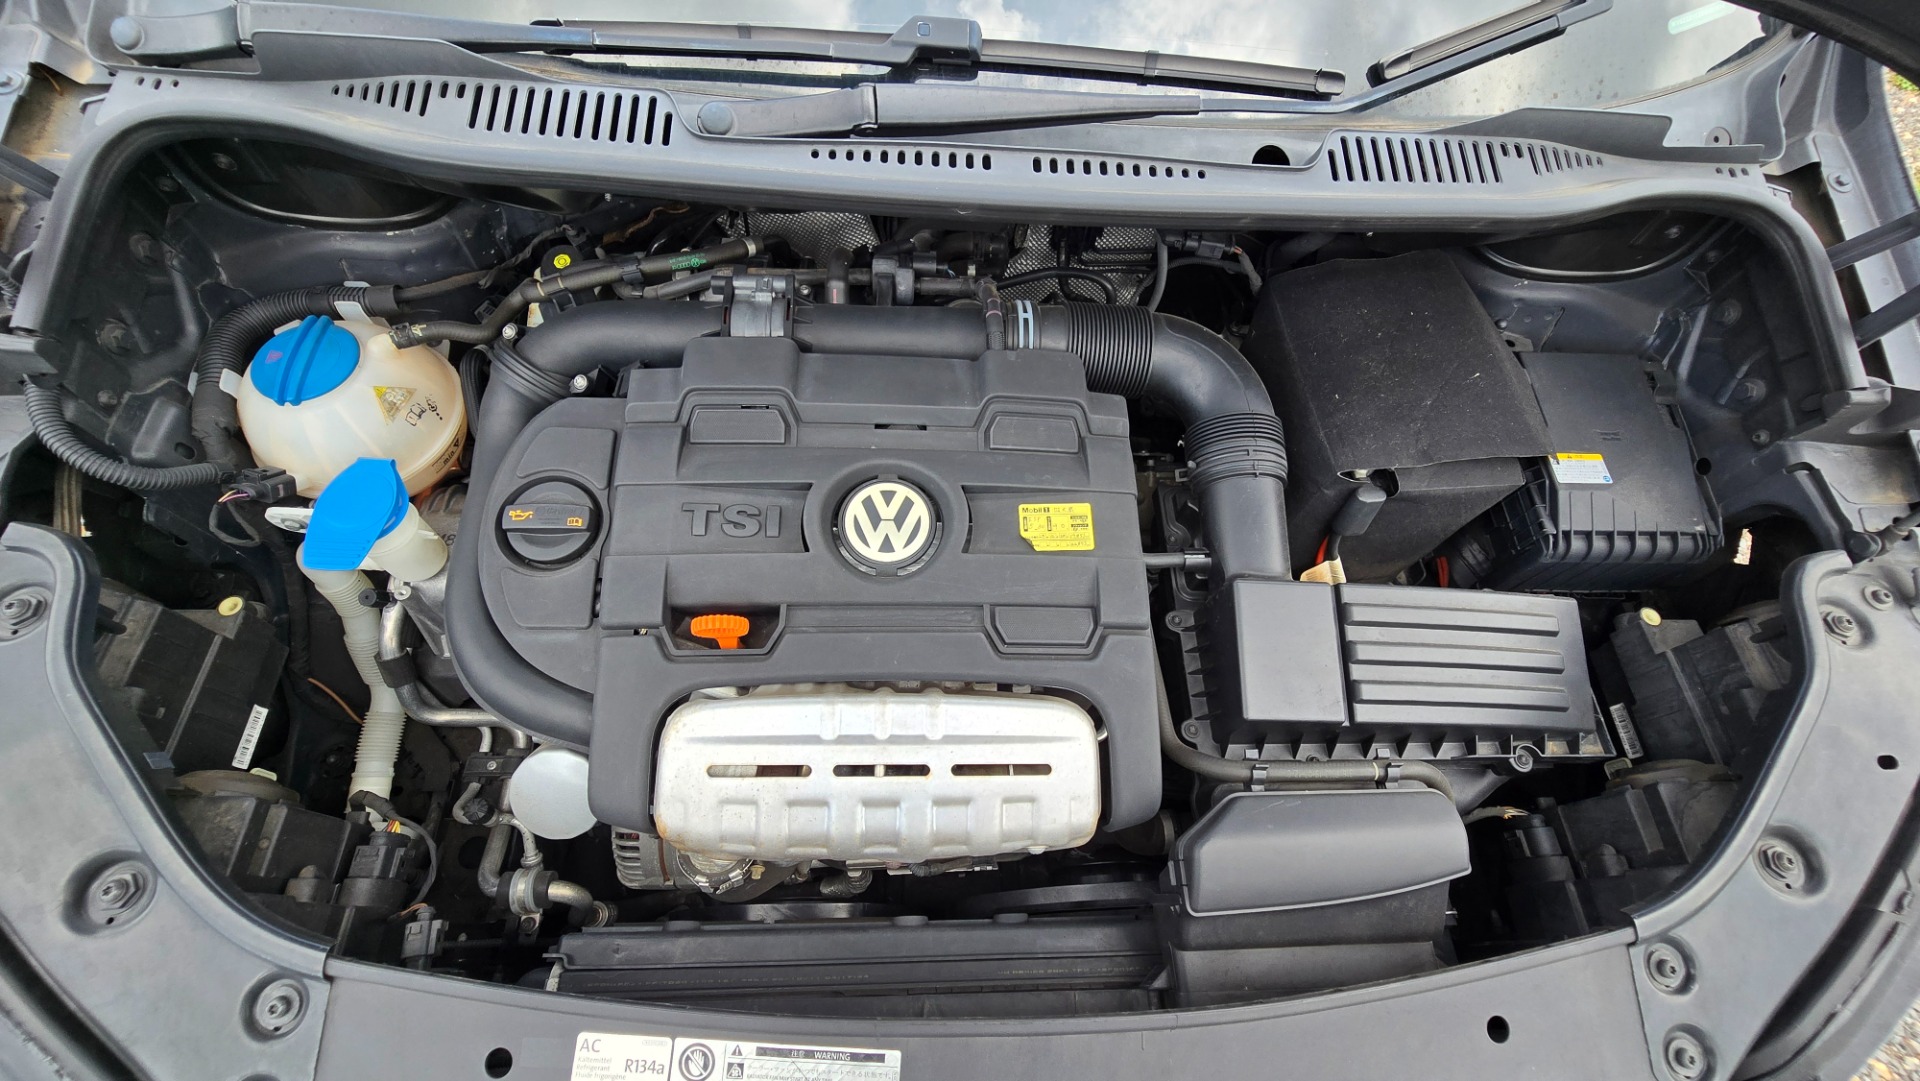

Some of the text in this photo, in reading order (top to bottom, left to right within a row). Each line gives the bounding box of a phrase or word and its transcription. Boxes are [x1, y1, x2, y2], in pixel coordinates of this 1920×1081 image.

[682, 502, 782, 538] TSI
[579, 1038, 601, 1053] AC
[814, 1051, 851, 1061] WARNING
[576, 1064, 610, 1072] Refrigerant
[624, 1058, 665, 1075] R134a
